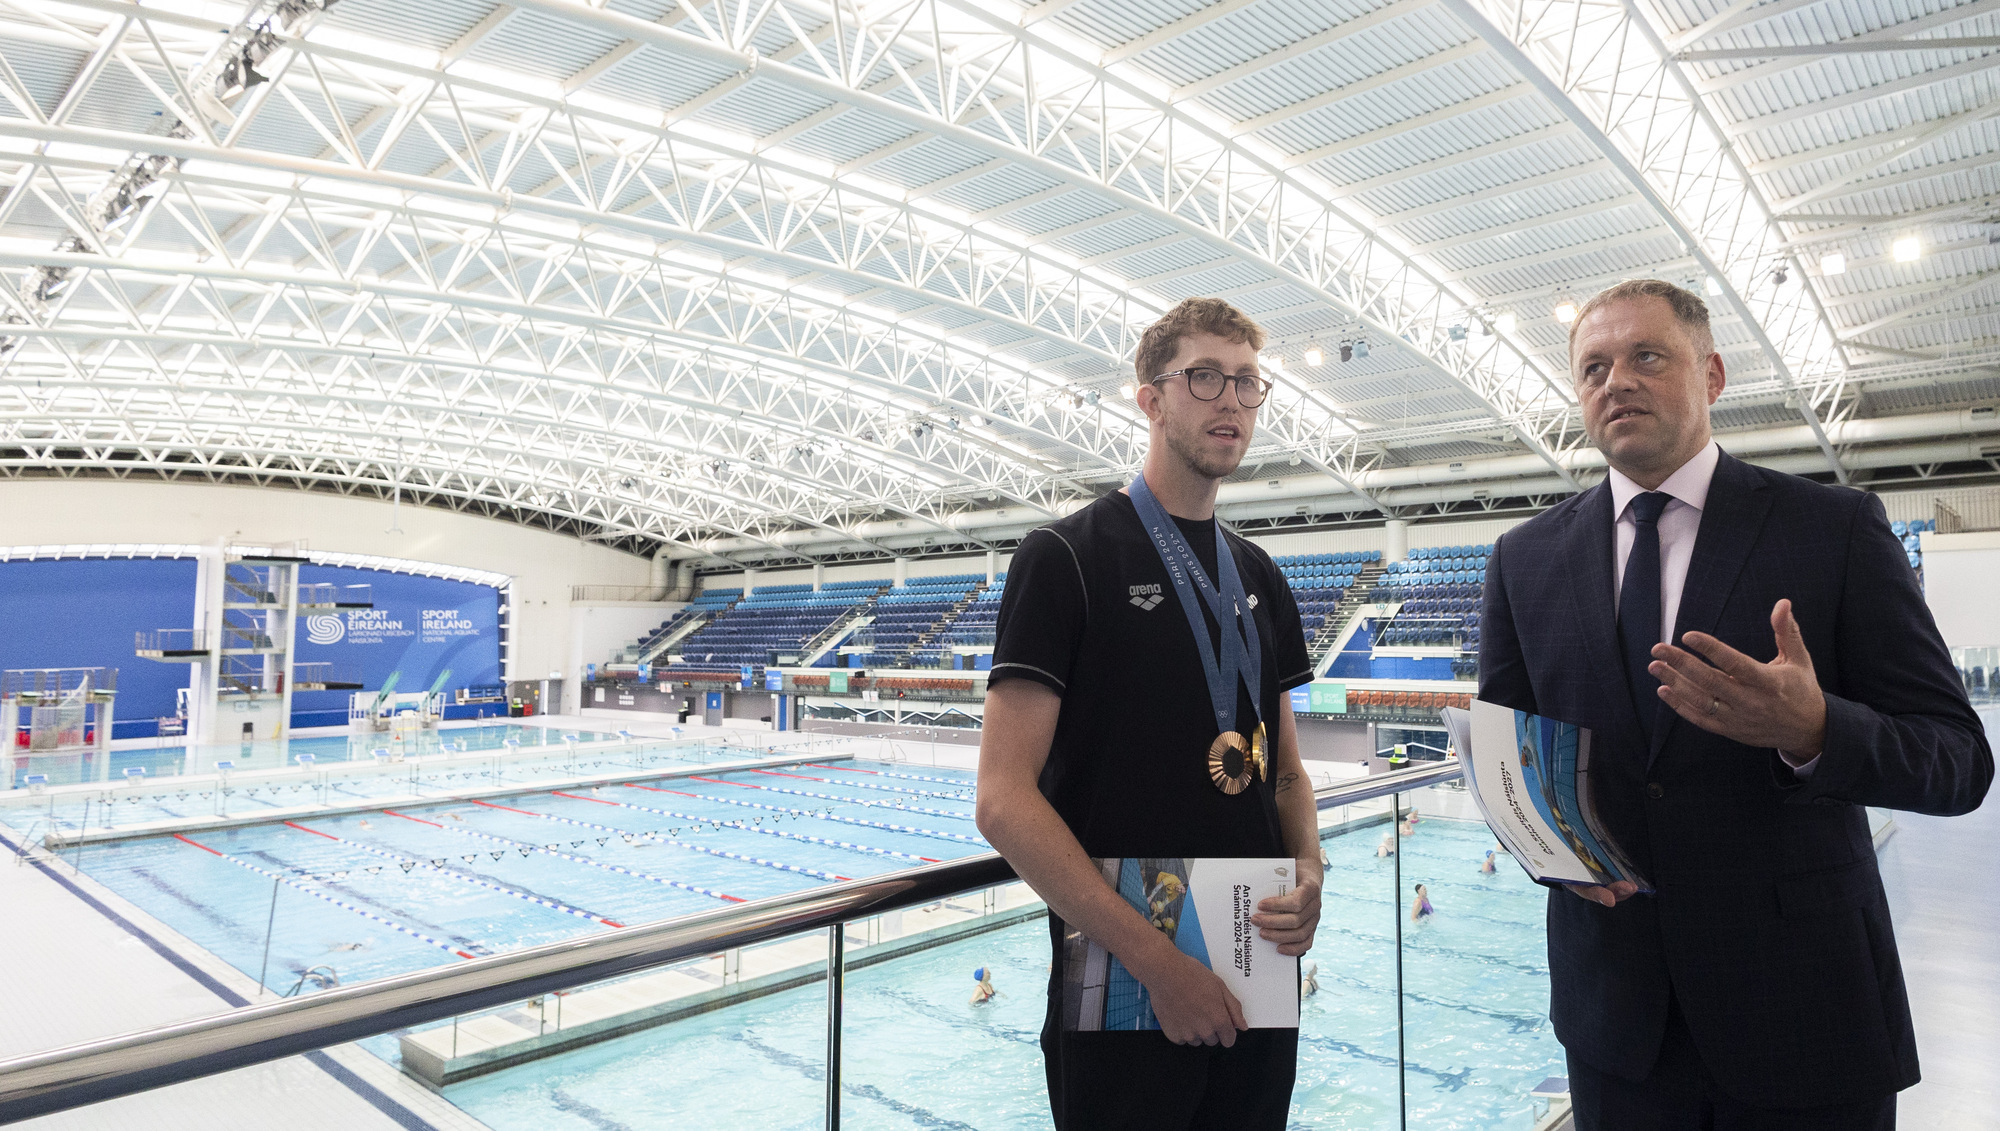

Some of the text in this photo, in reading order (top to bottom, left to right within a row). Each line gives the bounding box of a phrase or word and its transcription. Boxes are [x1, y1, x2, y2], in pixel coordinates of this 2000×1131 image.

[1153, 526, 1185, 585] PARIS 2024
[1169, 533, 1208, 588] PARIS 2024
[1129, 583, 1162, 596] arena
[347, 608, 389, 620] SPÓRT
[422, 609, 459, 620] SPORT
[347, 619, 403, 630] ÉIREANN
[422, 620, 473, 630] IRELAND
[1233, 884, 1242, 919] Snámha
[1243, 884, 1252, 977] An Straitéis Náisiúnta
